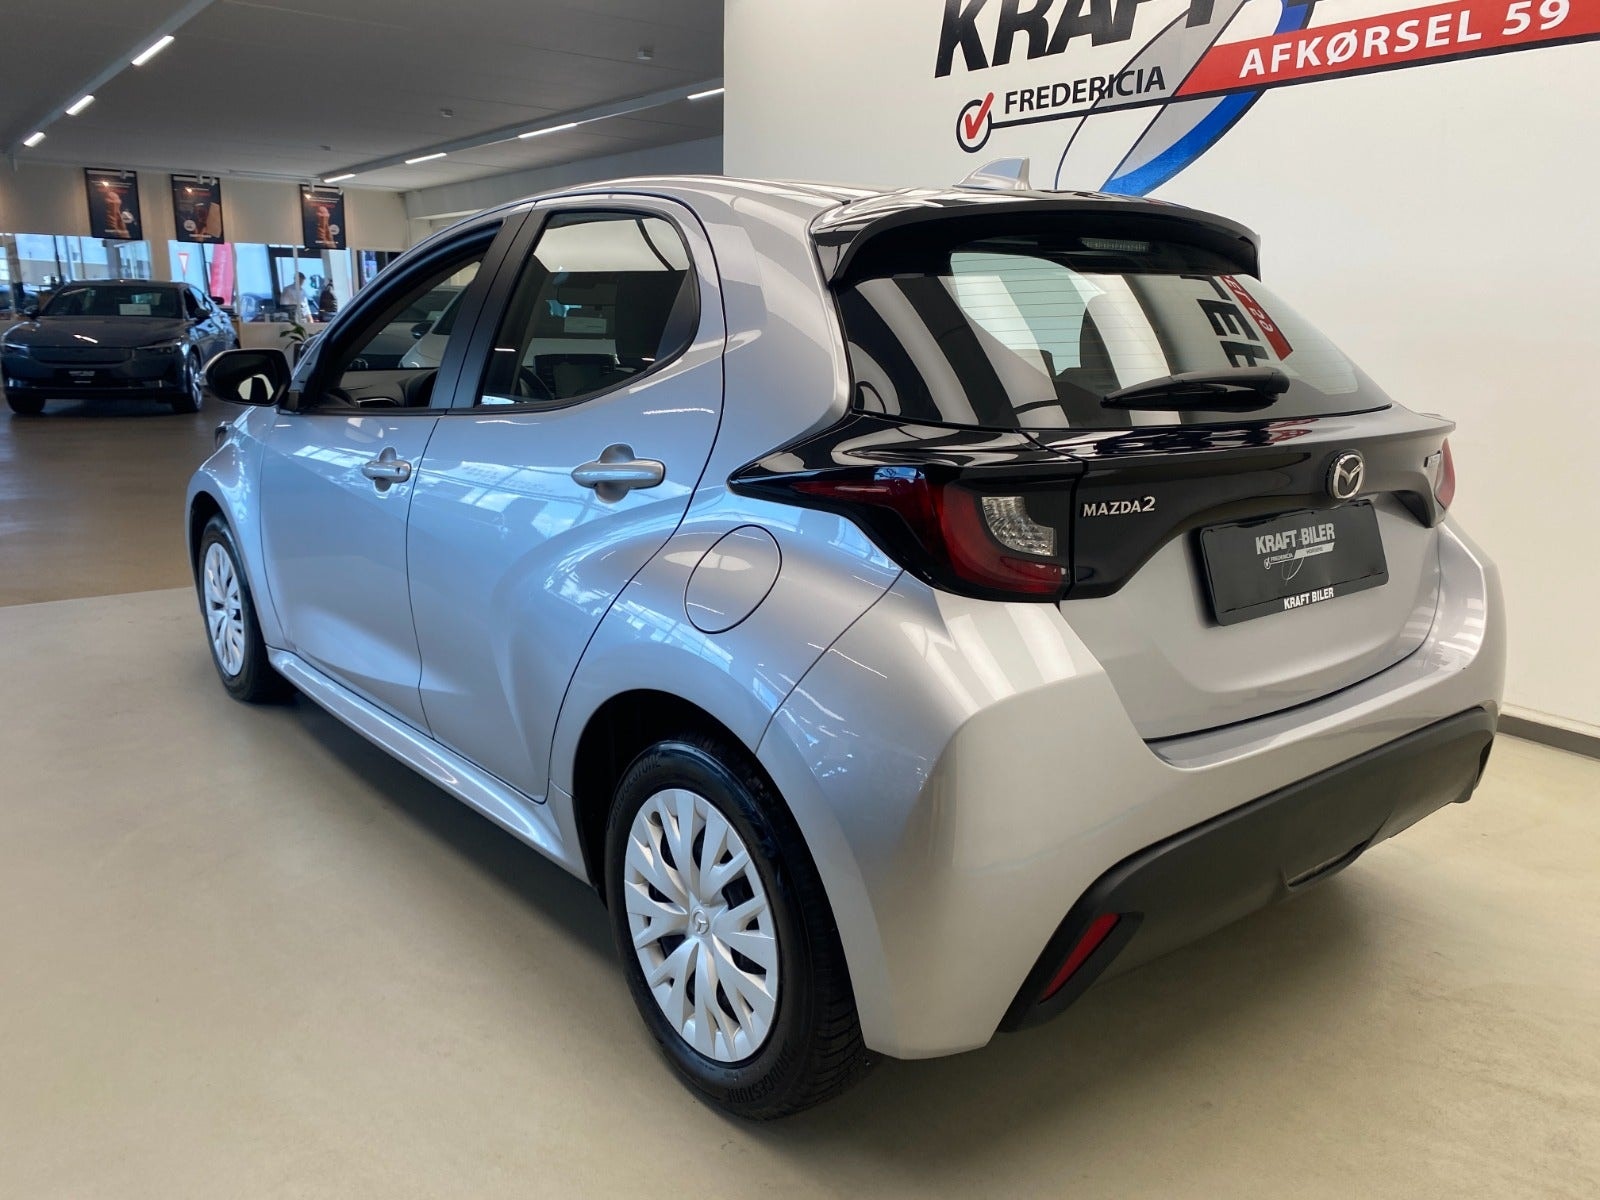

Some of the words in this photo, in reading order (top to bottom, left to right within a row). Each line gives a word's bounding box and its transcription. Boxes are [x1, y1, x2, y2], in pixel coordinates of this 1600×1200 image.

[1239, 10, 1481, 78] AFKØRSEL
[1502, 0, 1570, 35] 59
[1004, 66, 1166, 114] FREDERICIA
[1083, 496, 1156, 517] MAZDA2
[1255, 529, 1298, 555] KRAFT
[1300, 522, 1336, 546] BILER
[1283, 593, 1311, 610] KRAFT
[1311, 587, 1335, 602] BILER
